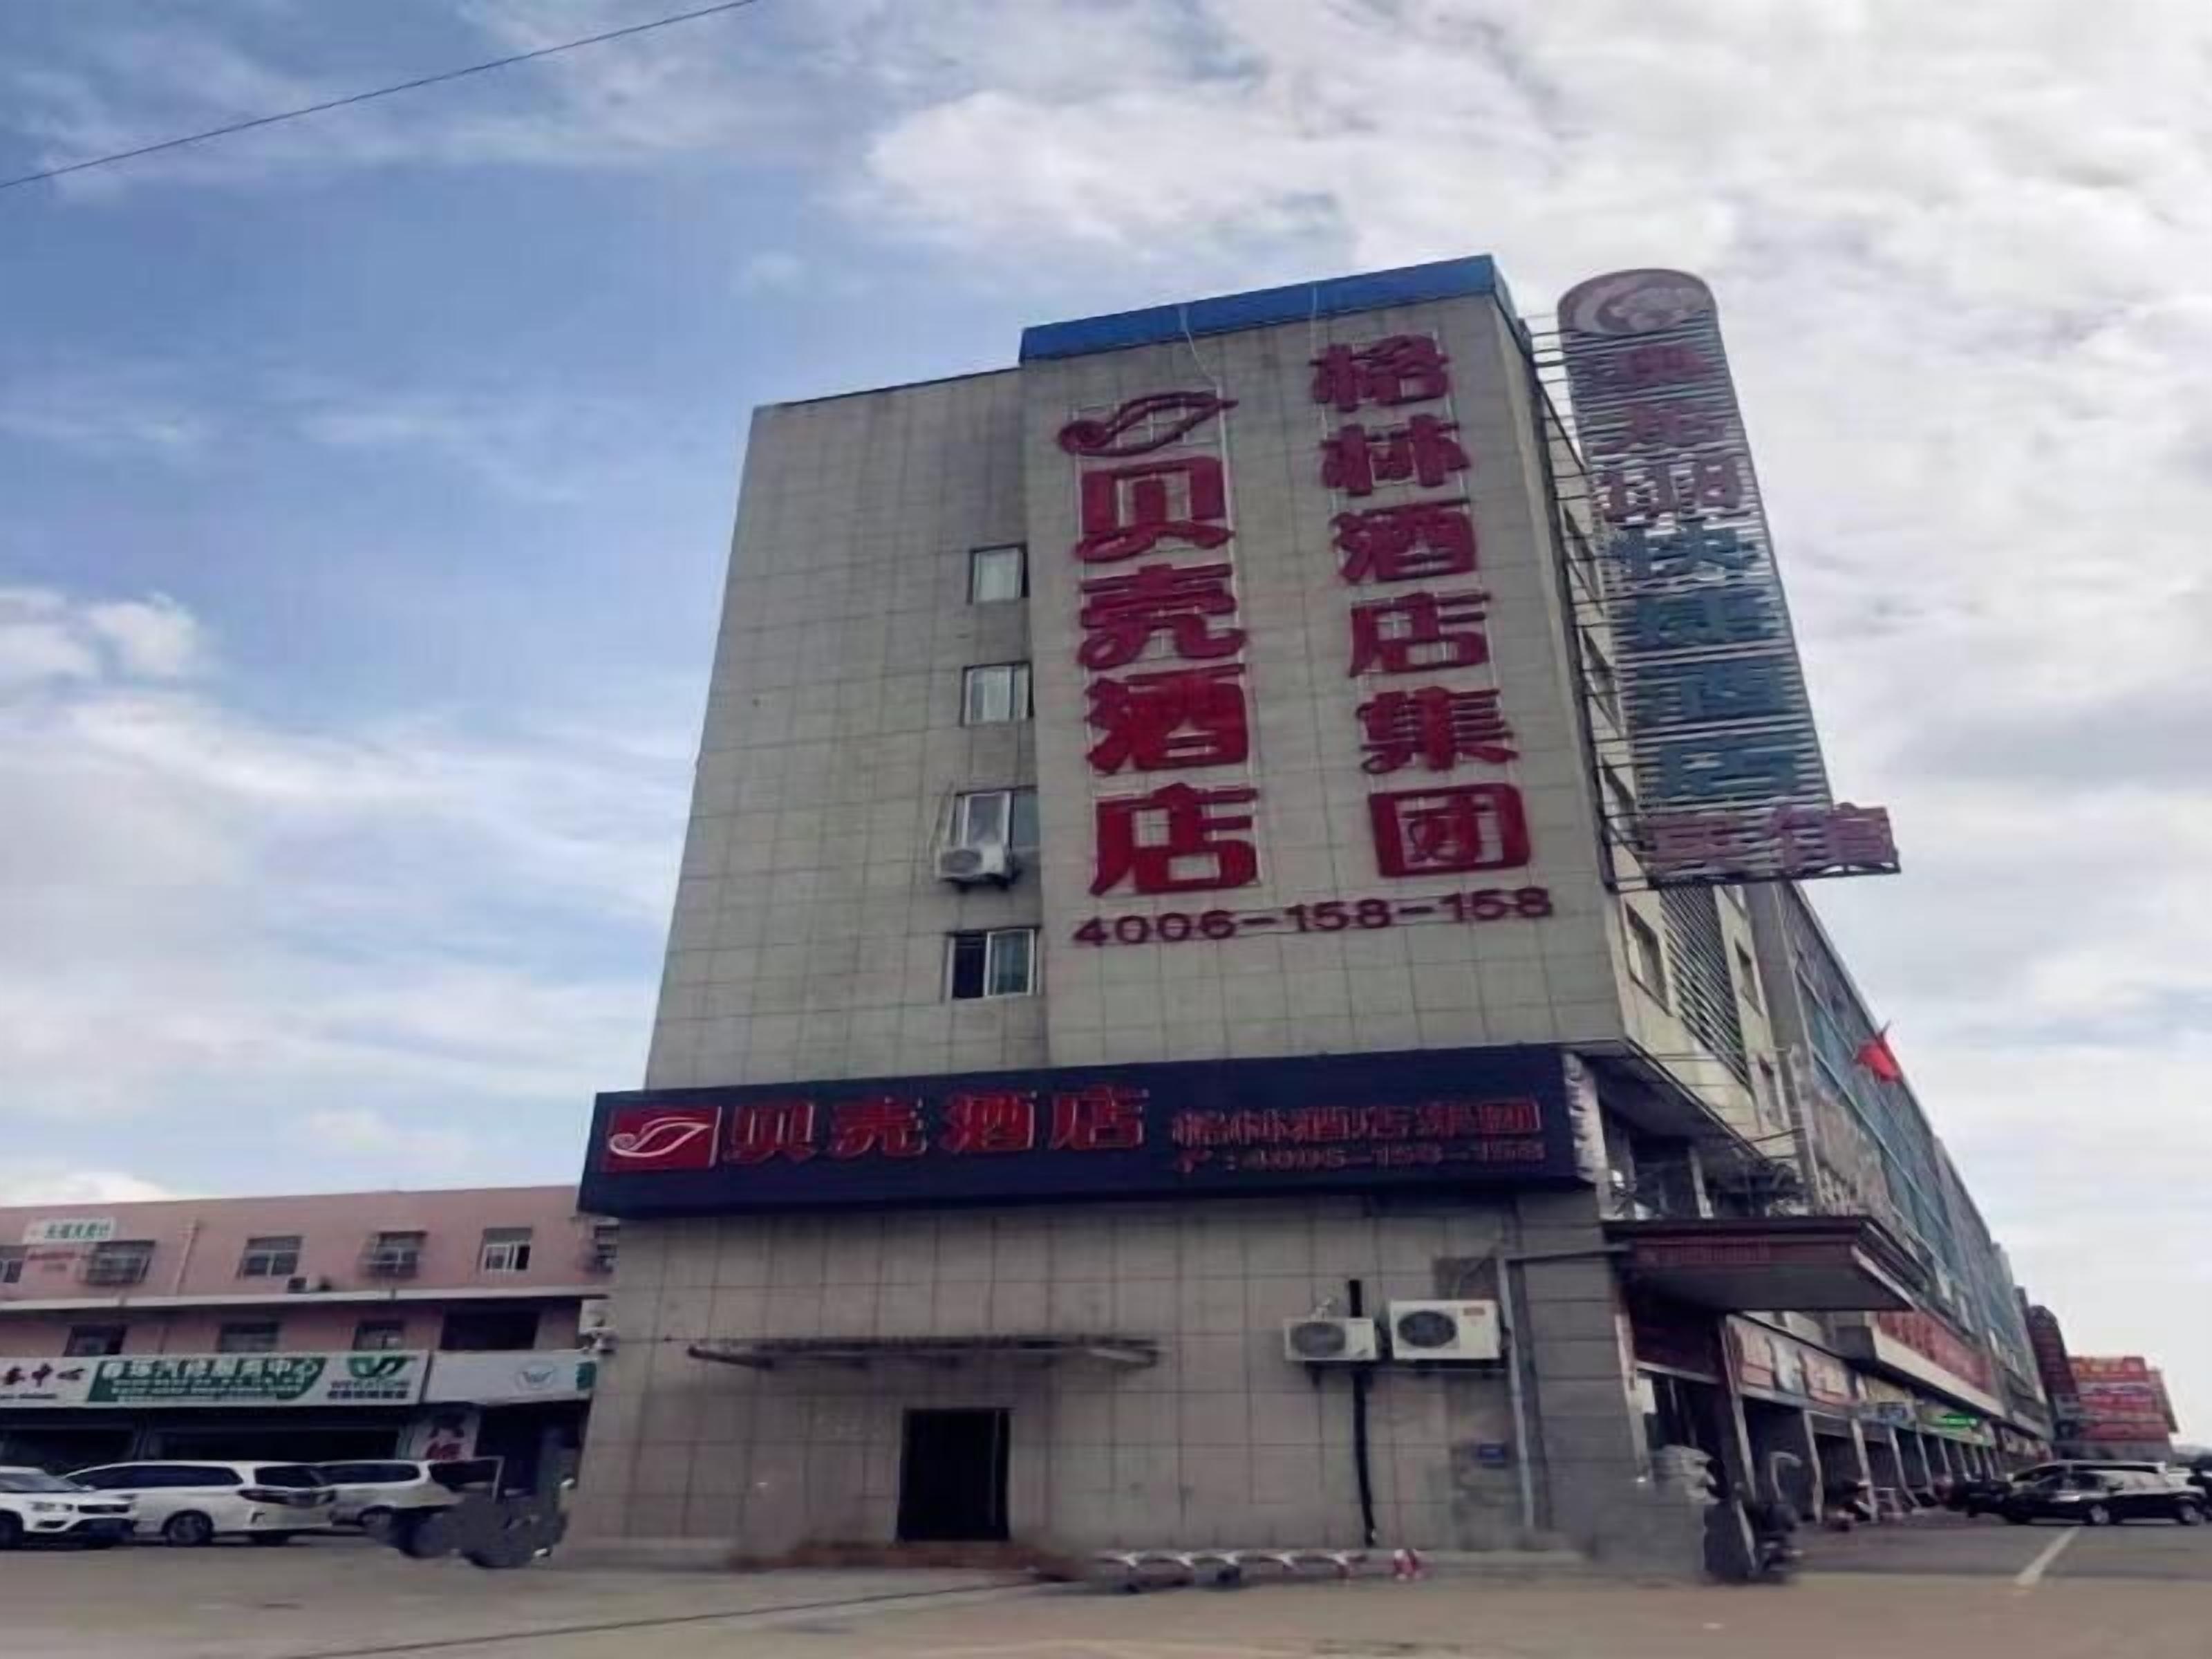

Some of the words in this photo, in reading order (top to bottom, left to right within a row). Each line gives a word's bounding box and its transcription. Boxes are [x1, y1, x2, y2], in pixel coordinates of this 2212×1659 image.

[1075, 455, 1259, 896] 贝壳酒店
[1309, 335, 1530, 878] 格林酒店集团
[1073, 885, 1554, 947] 4006-158-158
[722, 1083, 1150, 1166] 贝壳酒店
